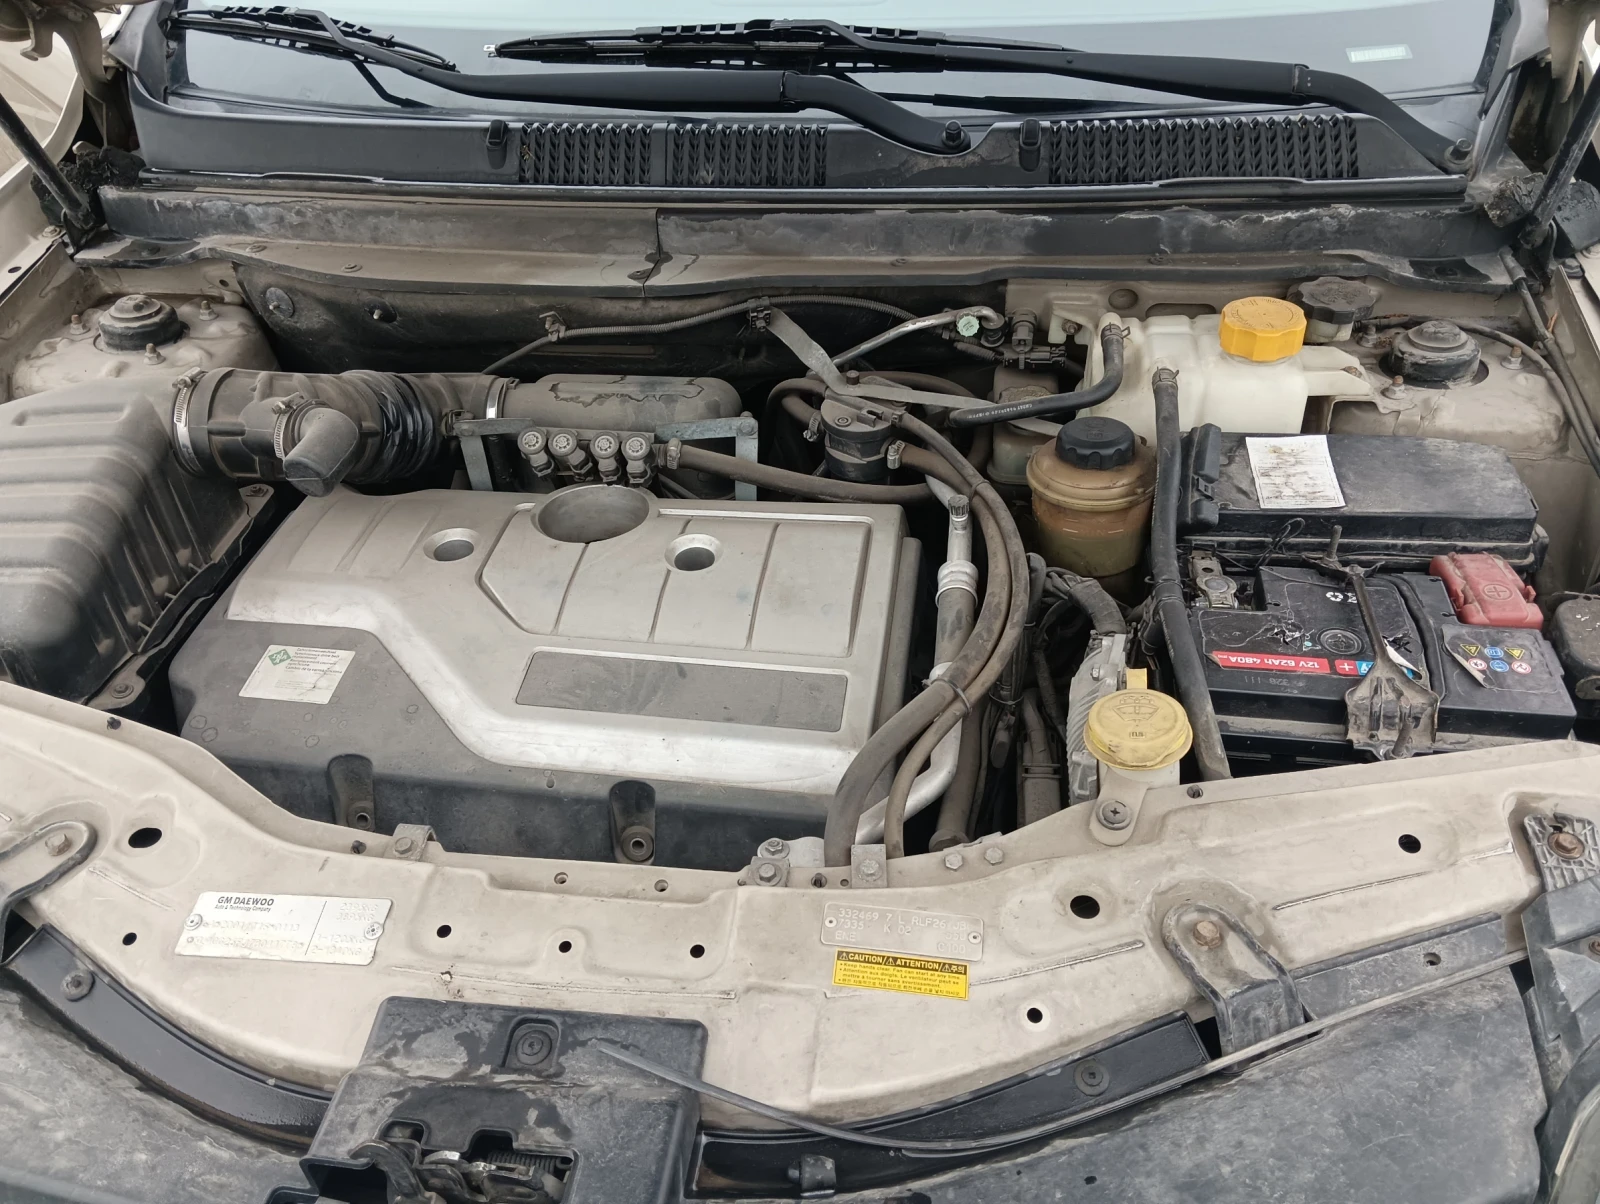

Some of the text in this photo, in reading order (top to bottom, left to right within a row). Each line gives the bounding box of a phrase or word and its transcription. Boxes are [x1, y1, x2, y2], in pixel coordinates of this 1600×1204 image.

[1228, 655, 1262, 664] 480A
[1299, 661, 1320, 669] 12V
[217, 896, 275, 906] GM DAEWOO
[838, 908, 879, 921] 332469
[886, 912, 893, 922] 7
[898, 915, 905, 925] L
[838, 919, 865, 930] 7335
[884, 924, 891, 934] K
[898, 925, 912, 935] 02
[951, 965, 965, 974] 주의
